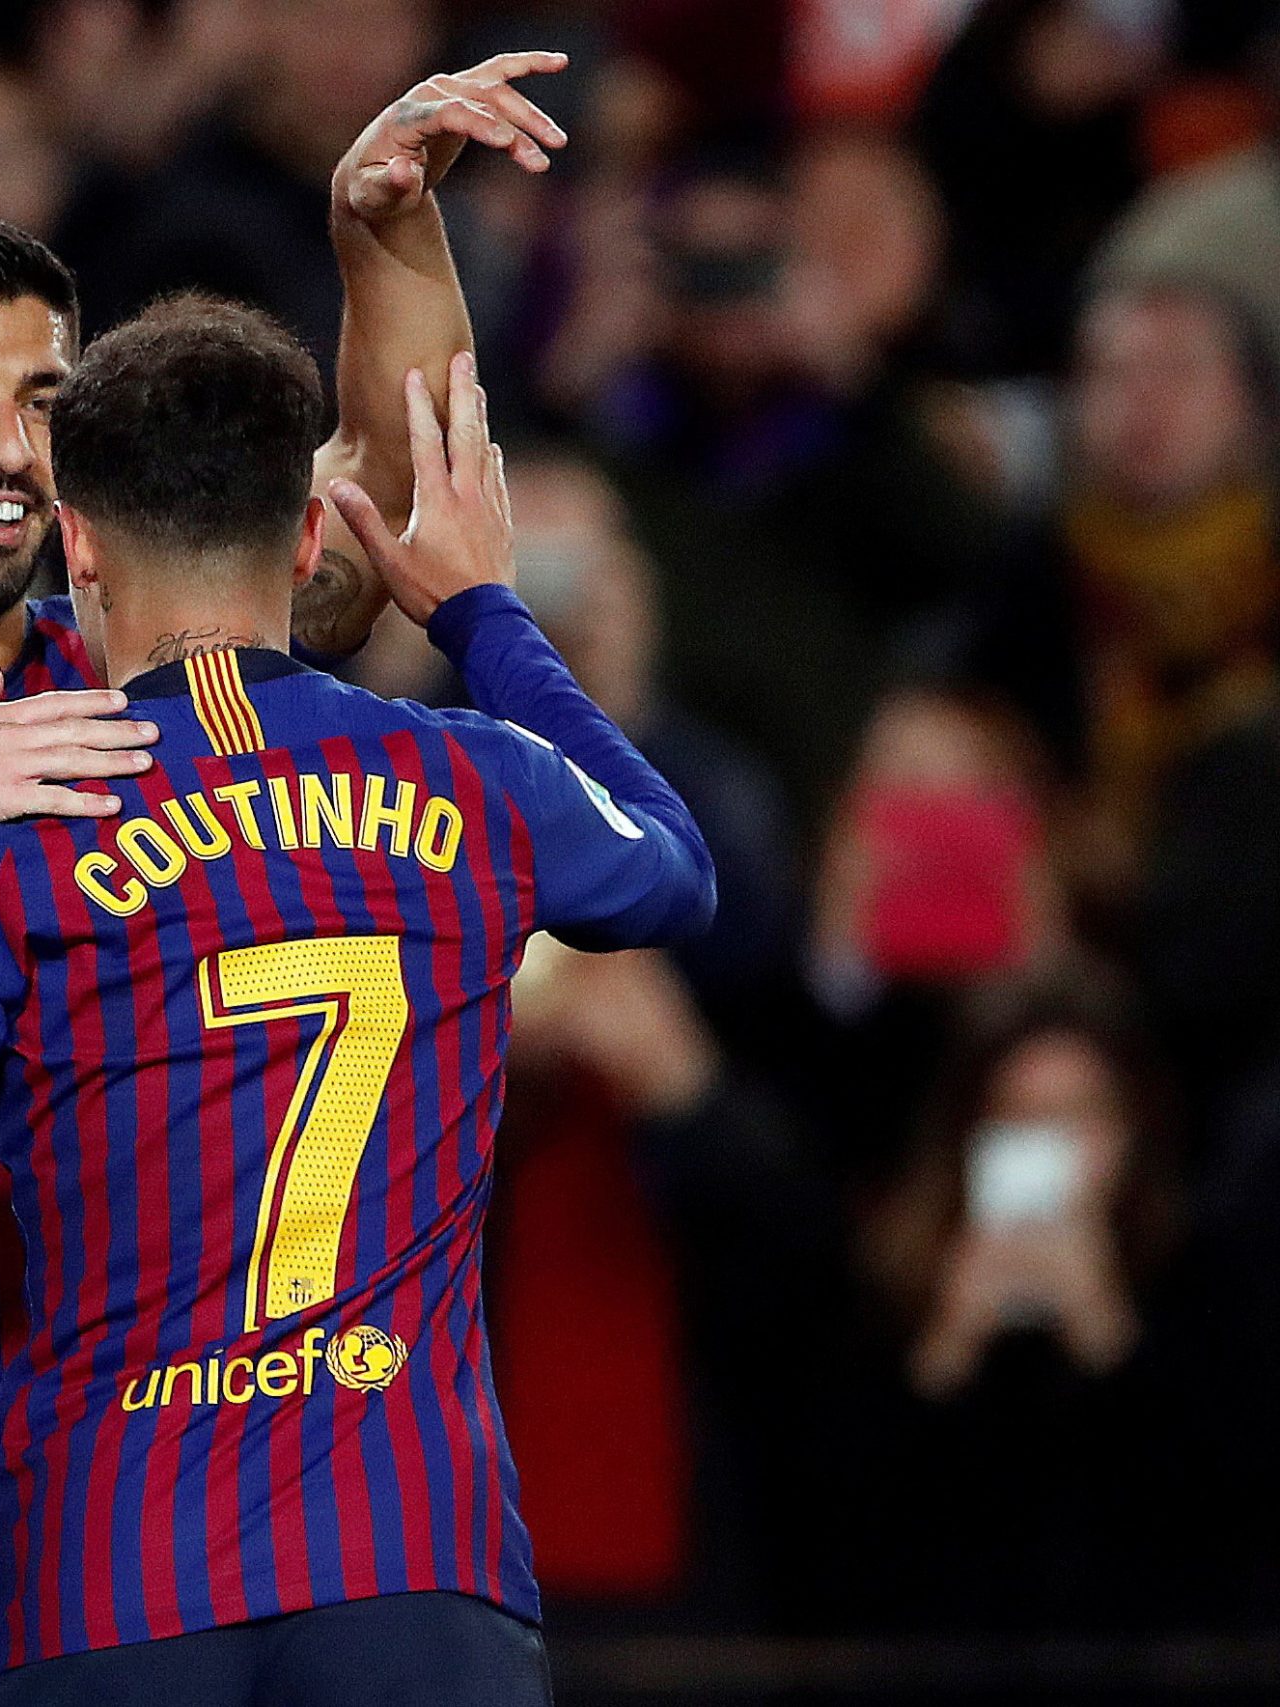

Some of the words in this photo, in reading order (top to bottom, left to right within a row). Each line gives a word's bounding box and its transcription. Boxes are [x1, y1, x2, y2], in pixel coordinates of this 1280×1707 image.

[74, 773, 463, 917] COUTINHO
[198, 935, 409, 1333] 7
[121, 1327, 325, 1412] unicef
